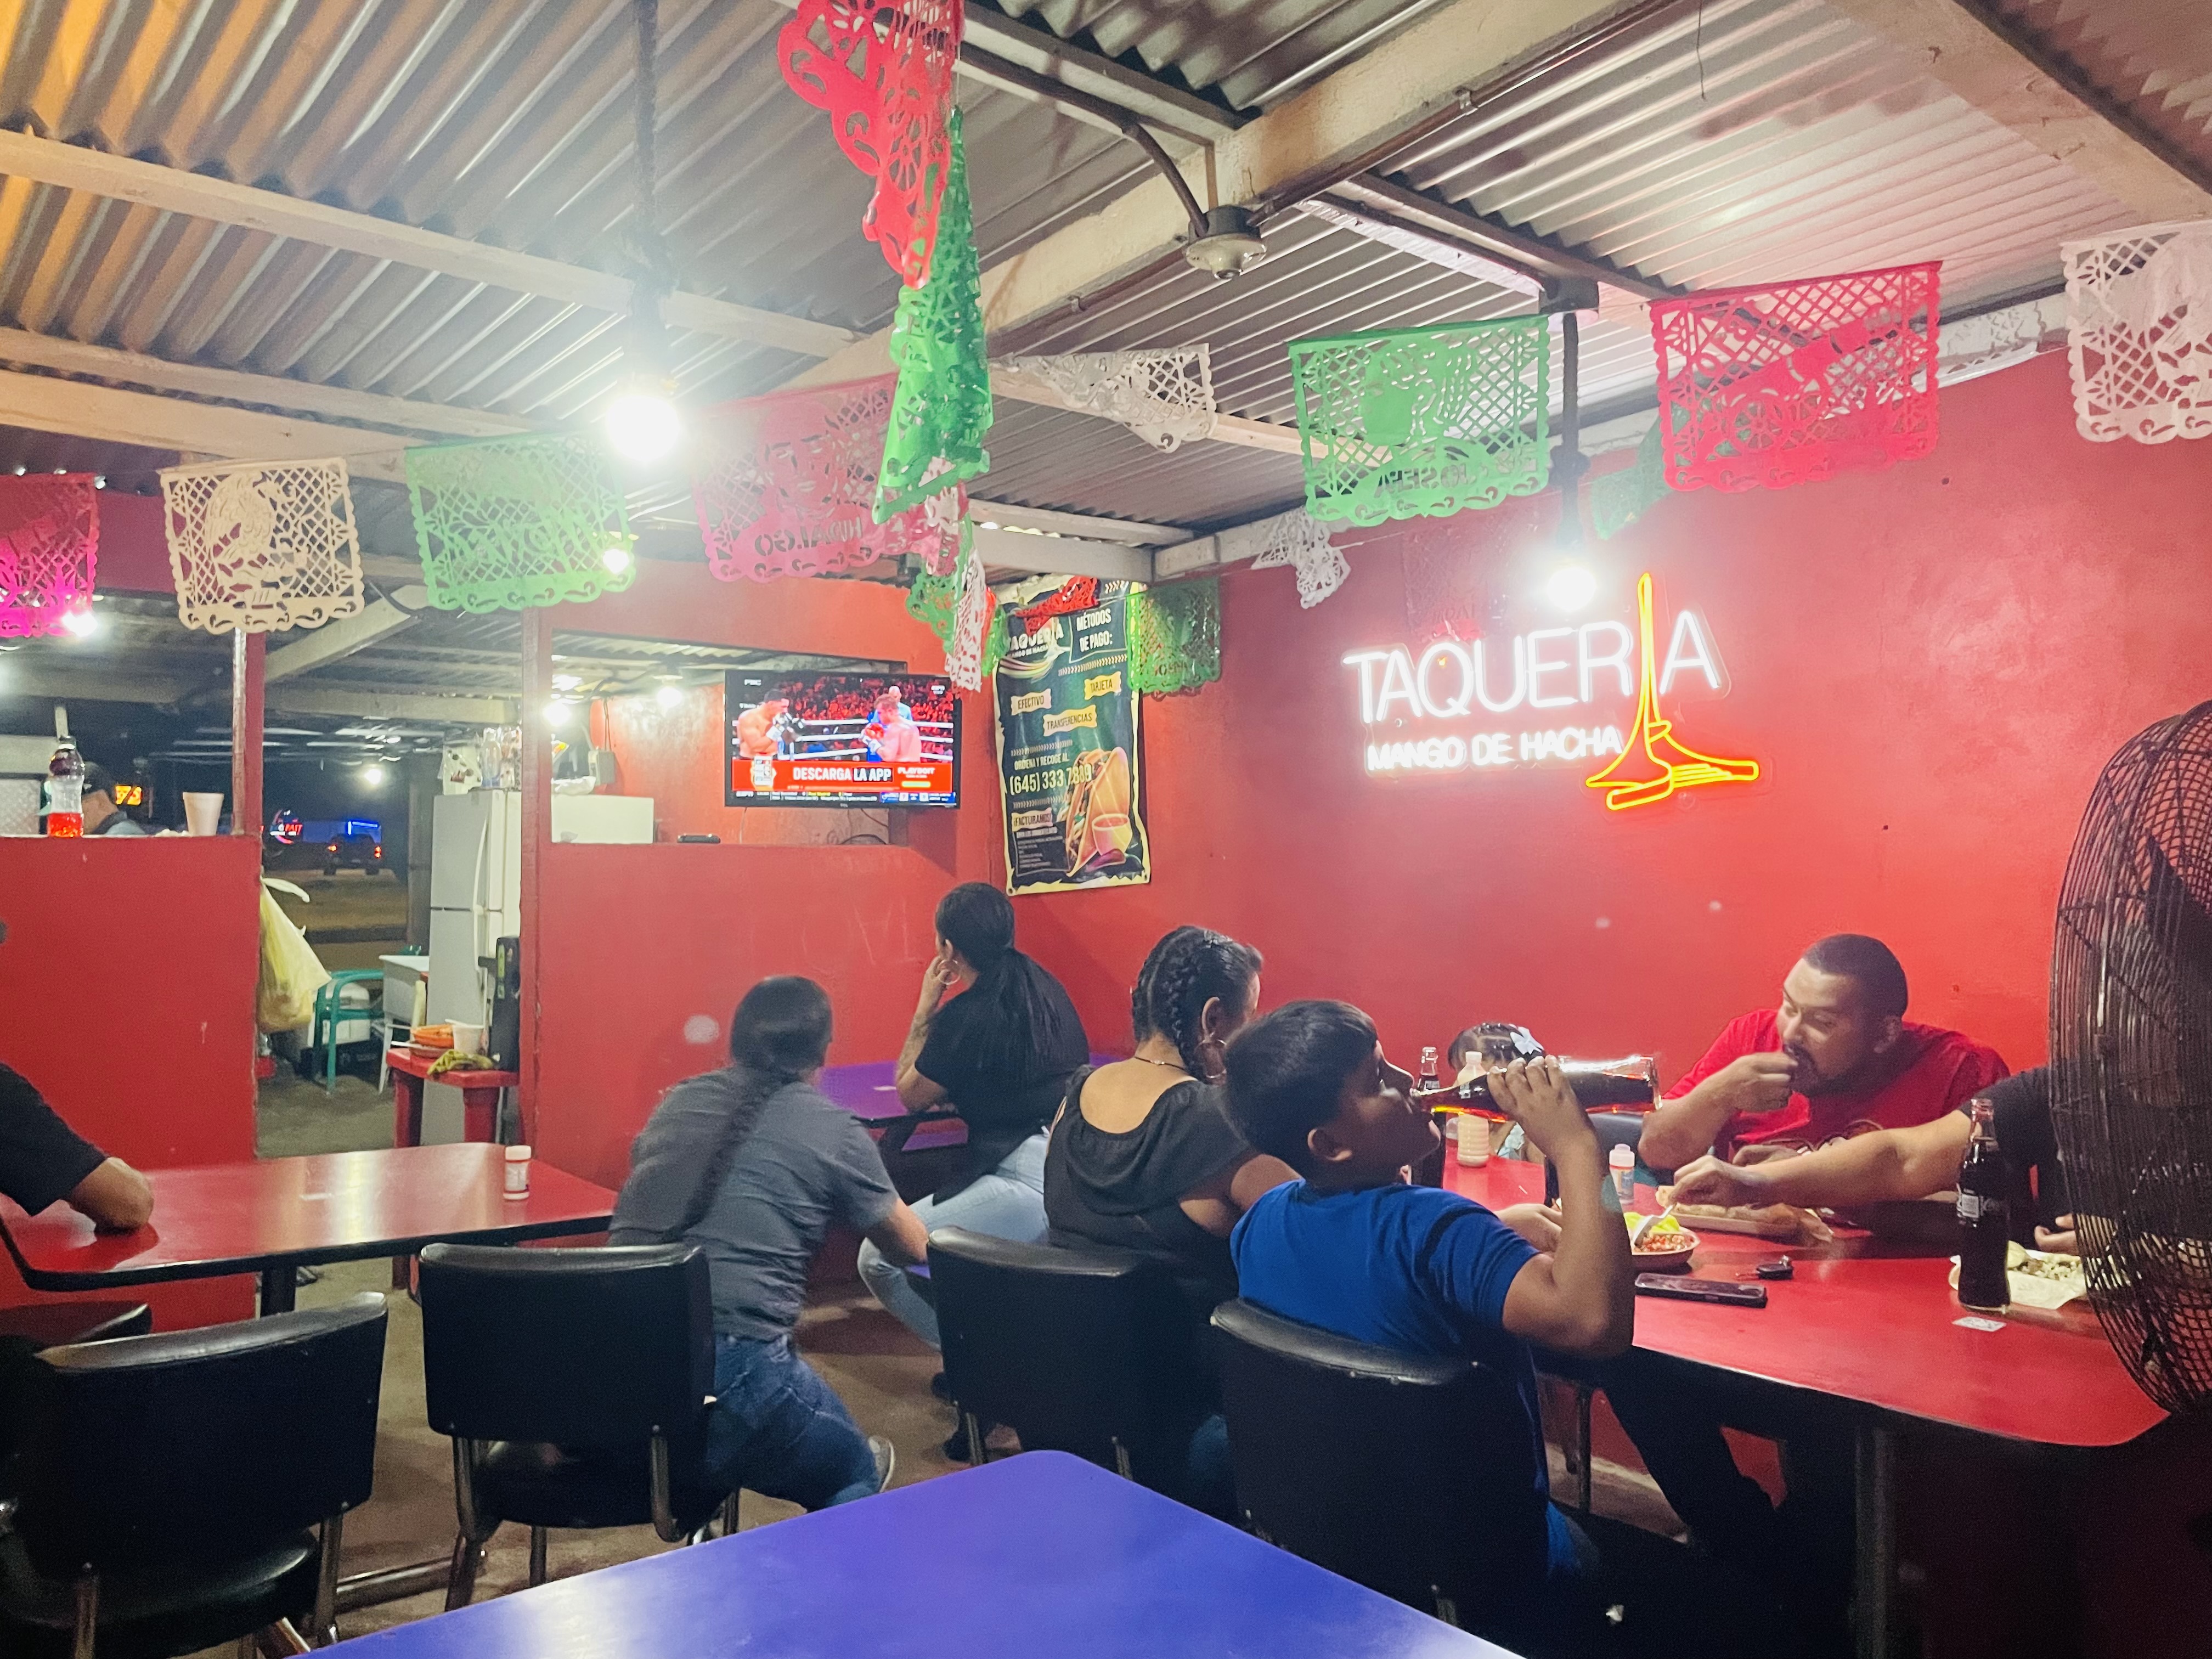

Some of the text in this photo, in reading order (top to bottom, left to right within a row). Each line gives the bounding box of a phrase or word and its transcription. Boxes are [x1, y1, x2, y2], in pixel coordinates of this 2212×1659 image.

[1076, 608, 1112, 631] MÉTODOS
[1080, 630, 1113, 652] DE PAGO:
[1090, 679, 1113, 692] TARJETA
[1018, 695, 1045, 709] EFECTIVO
[1047, 713, 1092, 730] TRANSFERENCIAS
[1368, 726, 1623, 771] MANGO DE HACHA
[1040, 754, 1062, 766] RECOGE
[793, 767, 891, 781] DESCARGA LA APP
[1009, 772, 1041, 795] (645)
[1042, 769, 1064, 789] 333
